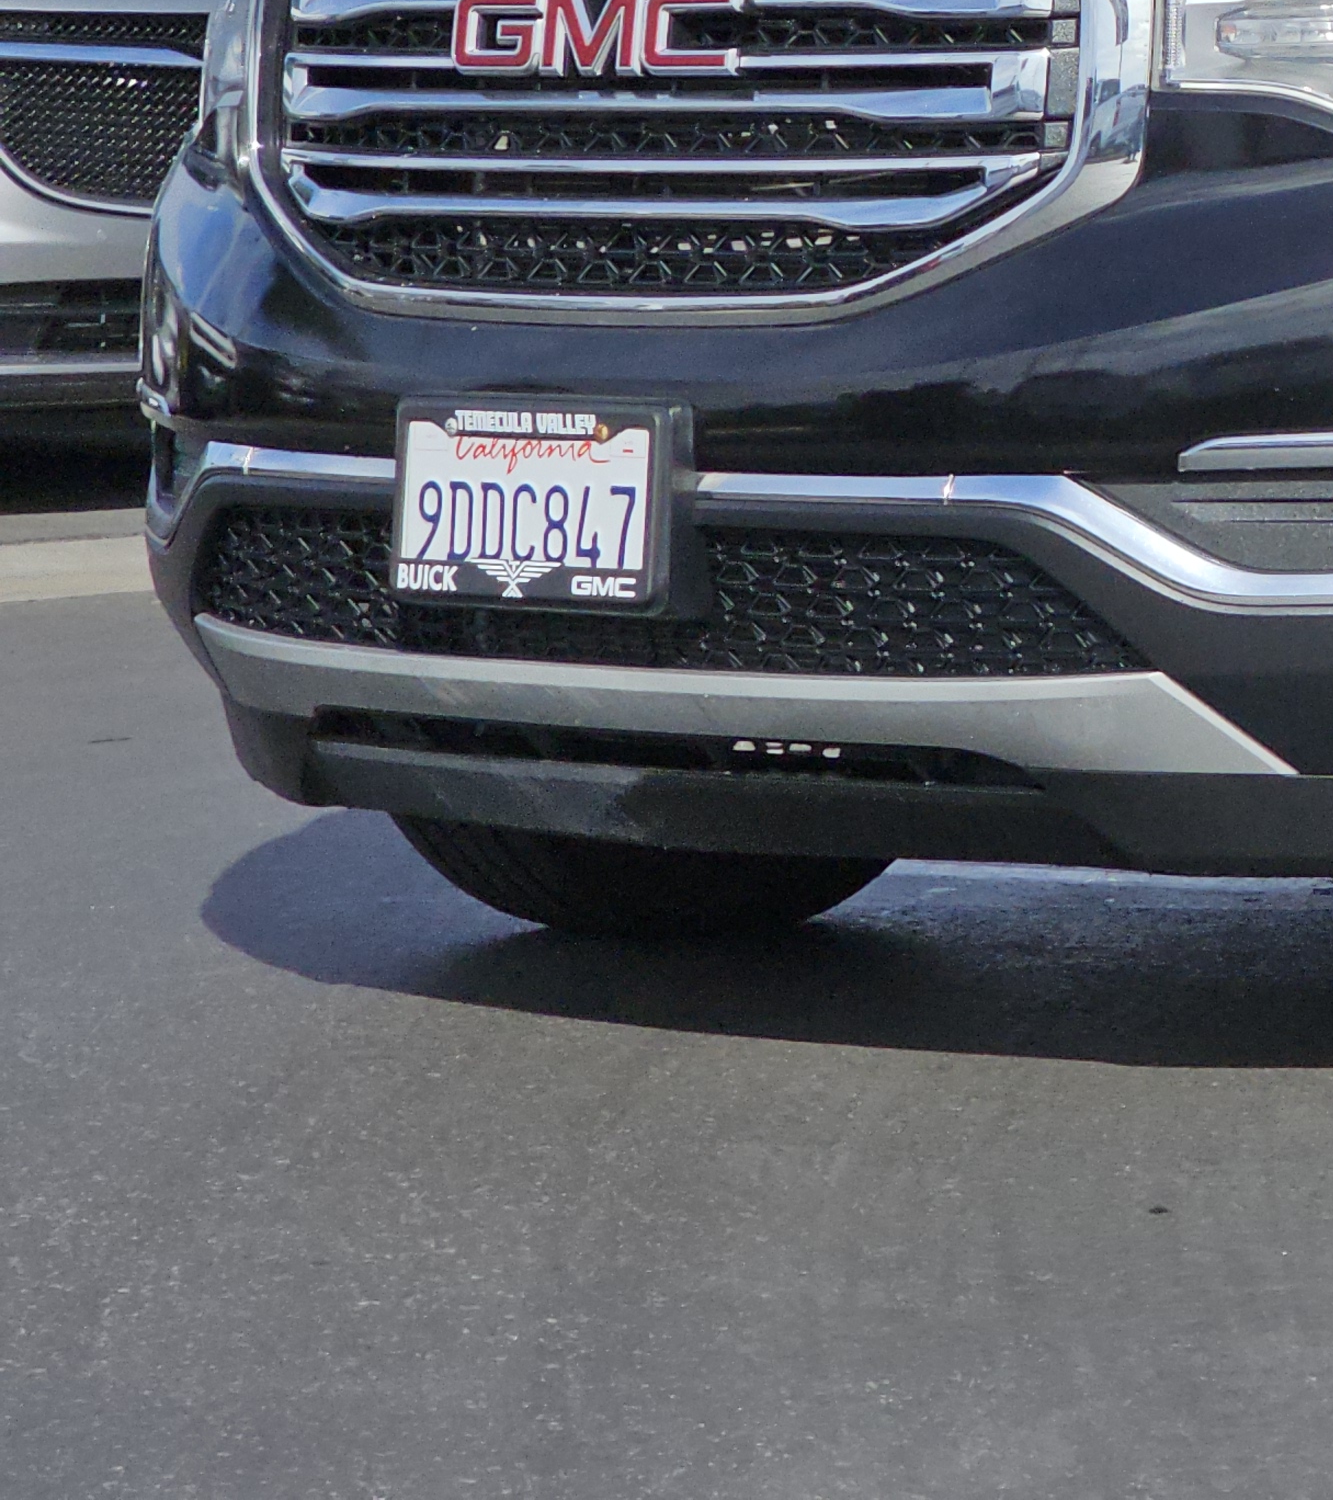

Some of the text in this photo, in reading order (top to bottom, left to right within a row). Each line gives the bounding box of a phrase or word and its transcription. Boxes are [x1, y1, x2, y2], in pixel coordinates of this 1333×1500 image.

[455, 410, 597, 435] TEMECULA VALLEY
[455, 435, 611, 475] California
[417, 480, 637, 570] 9DDC847
[397, 563, 637, 598] BUICK GMC
